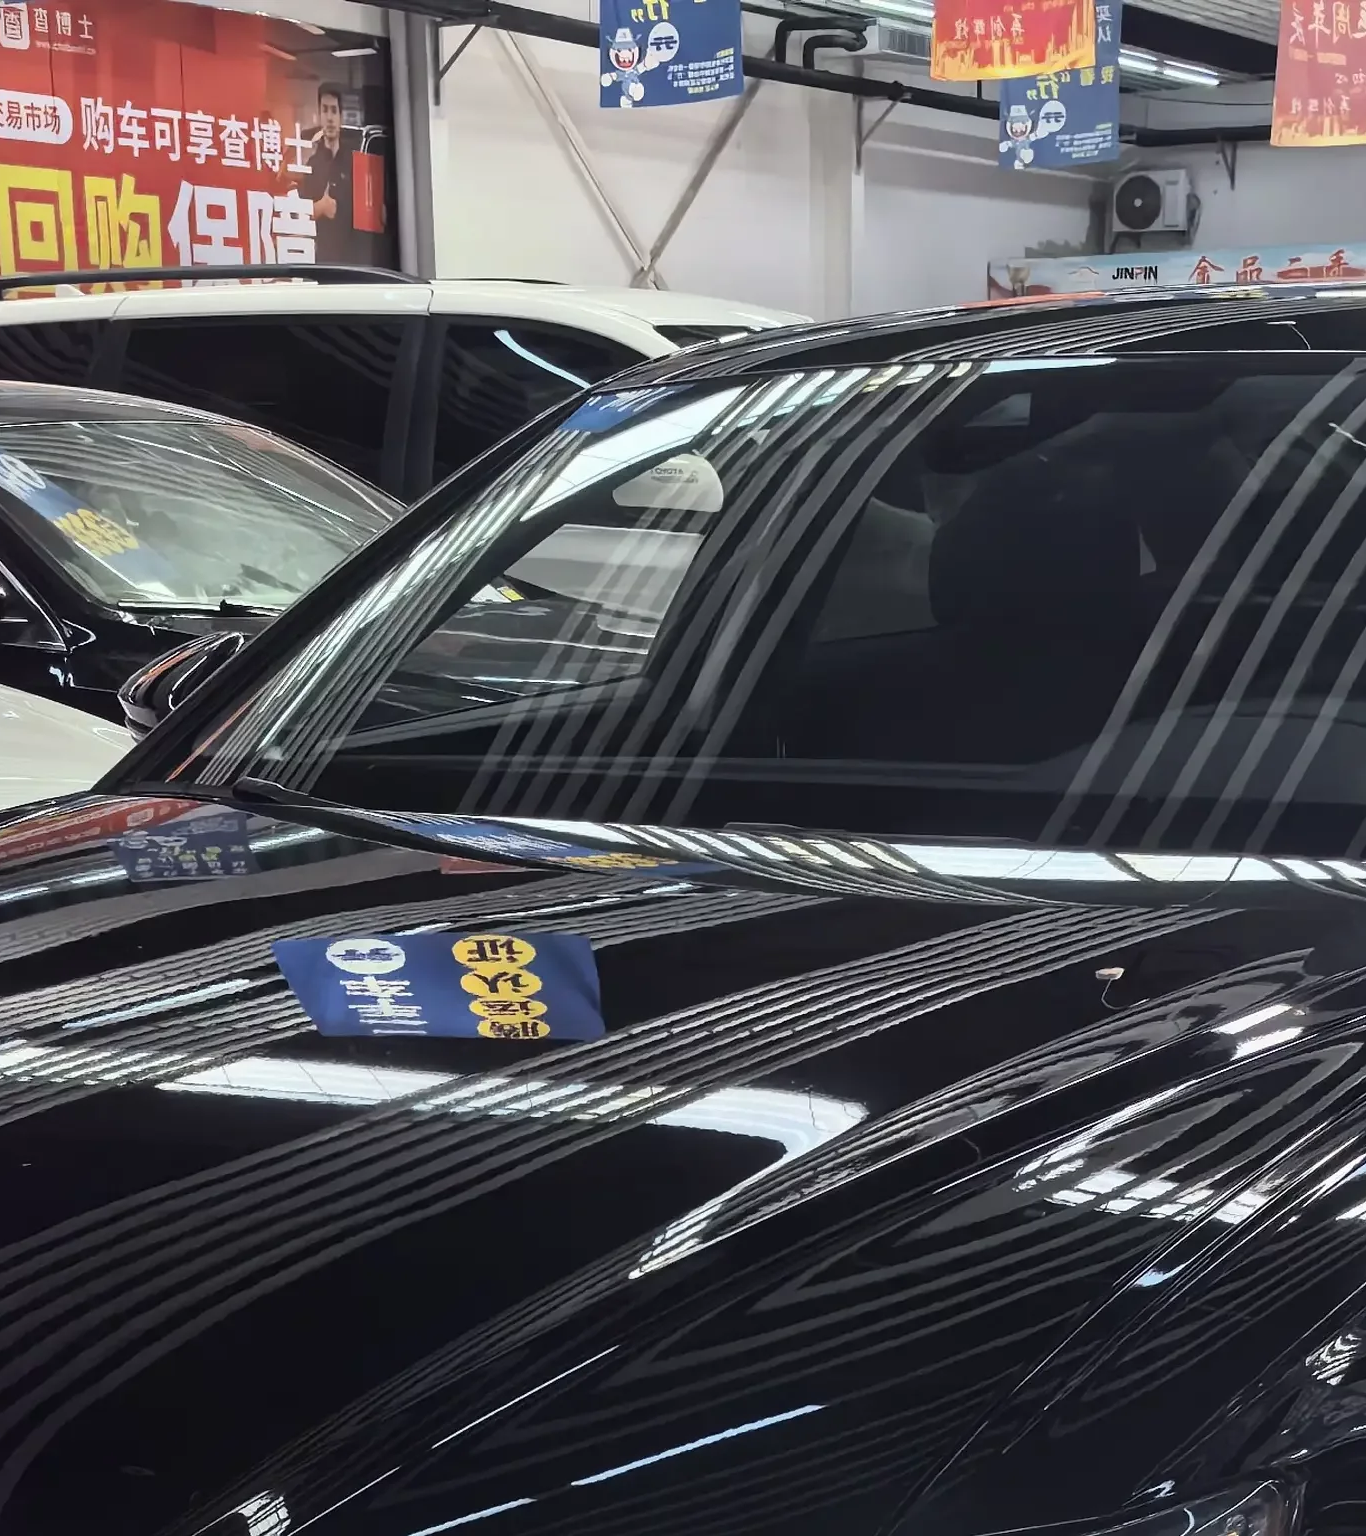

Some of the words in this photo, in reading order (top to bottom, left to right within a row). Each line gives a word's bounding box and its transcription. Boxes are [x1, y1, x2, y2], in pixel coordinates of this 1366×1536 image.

[32, 7, 94, 40] 查博士
[80, 96, 314, 175] 购车可享查博士
